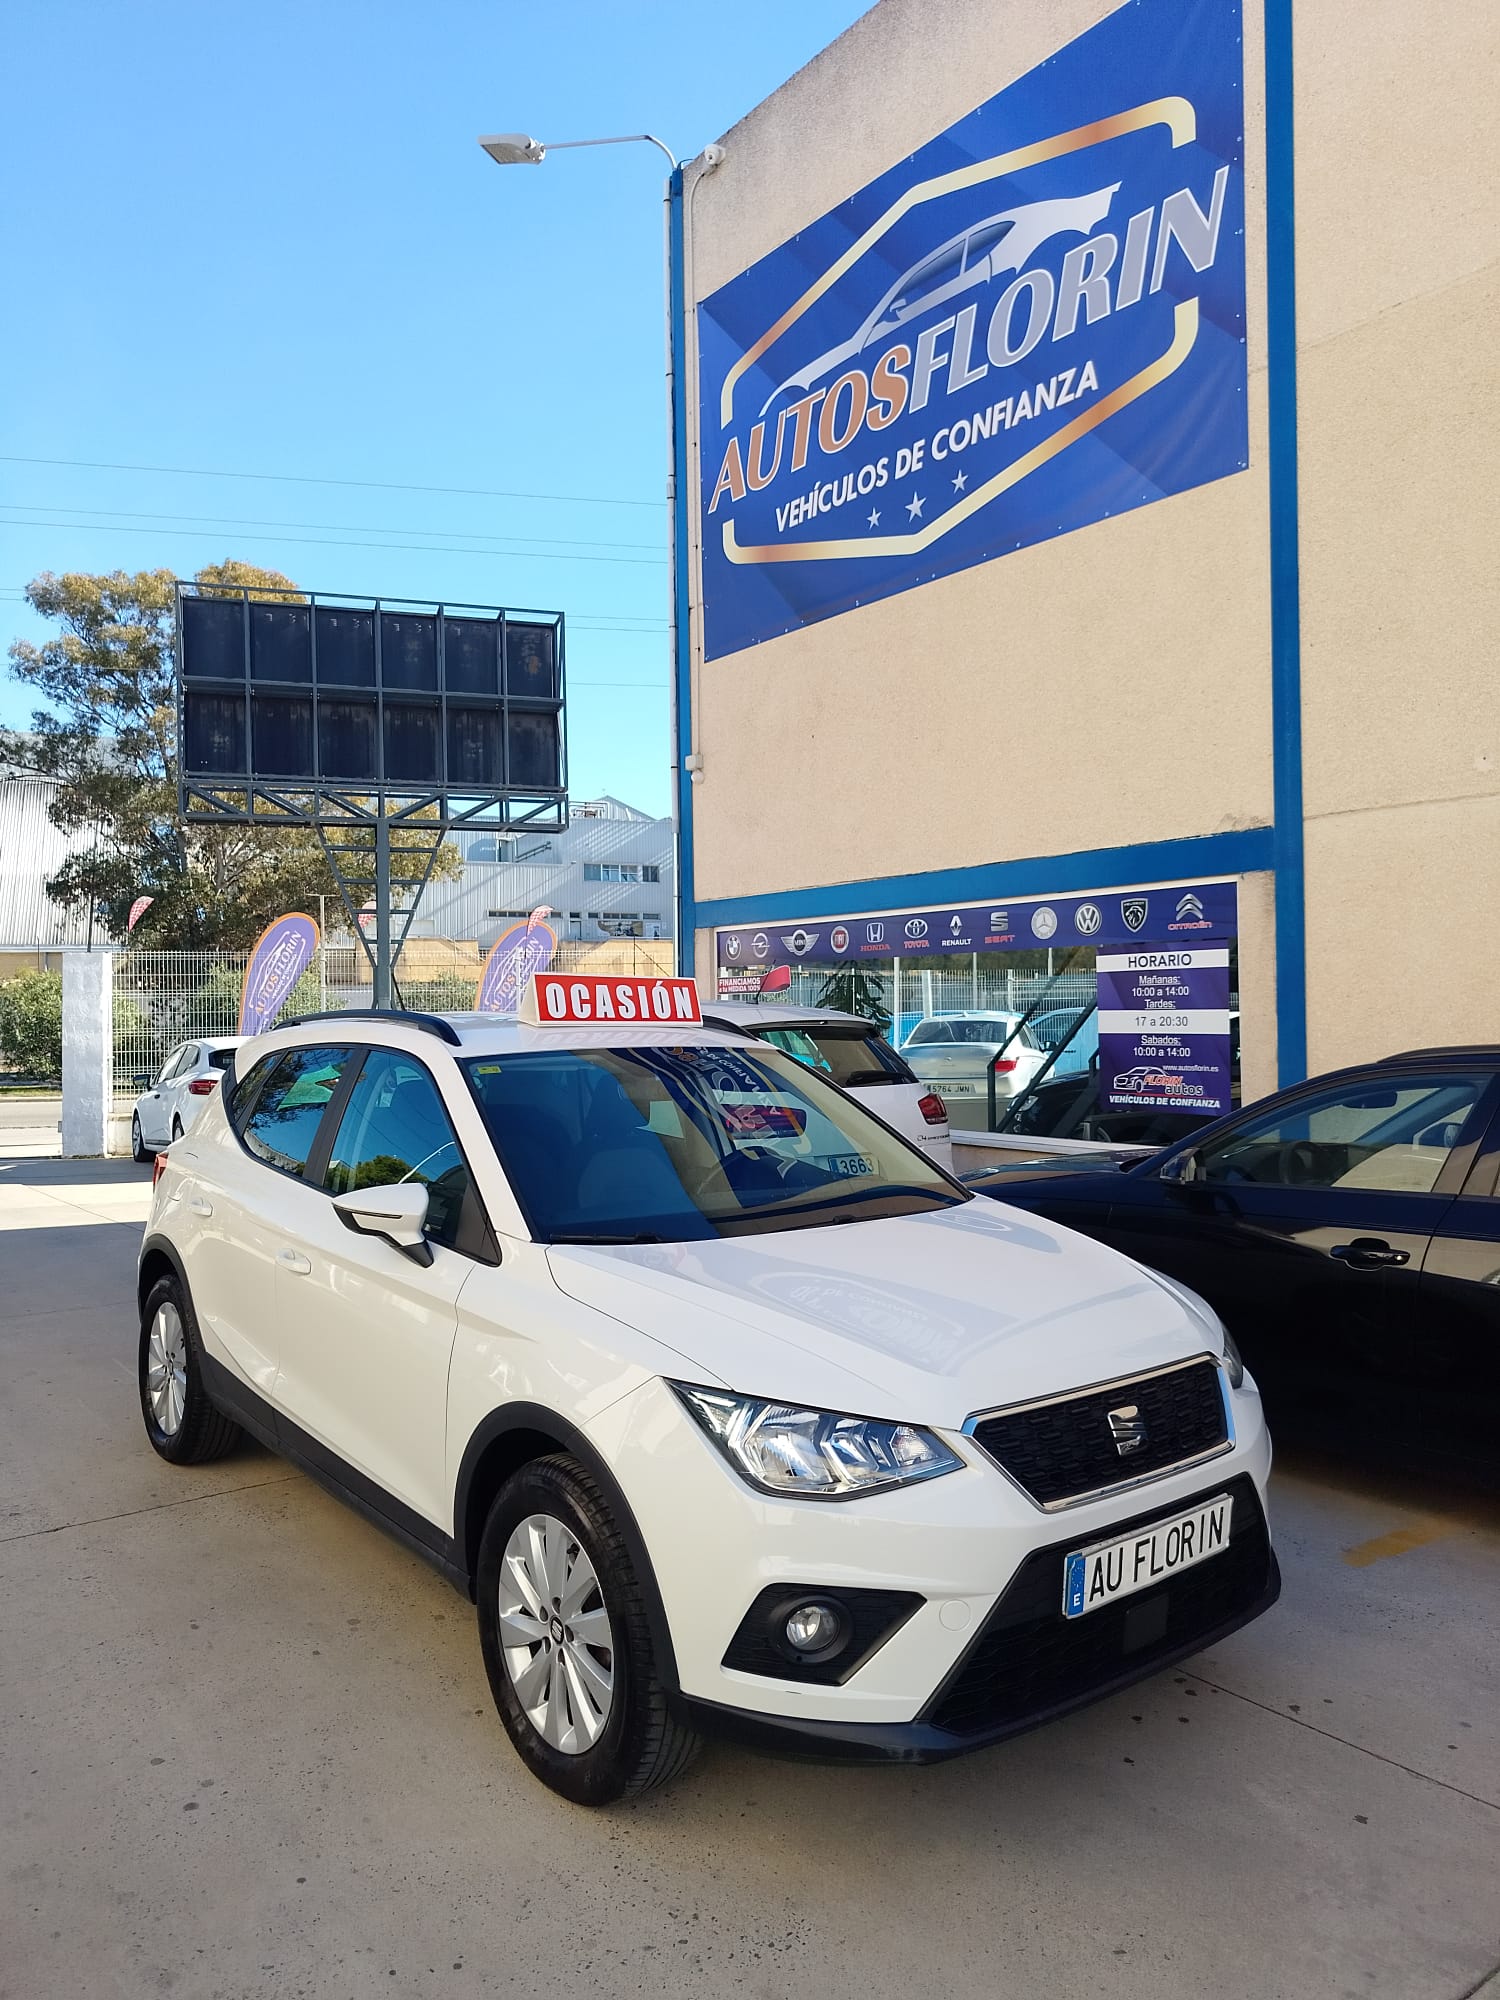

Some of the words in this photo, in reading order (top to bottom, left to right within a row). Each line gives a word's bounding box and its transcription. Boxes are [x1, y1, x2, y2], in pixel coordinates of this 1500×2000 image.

[775, 457, 889, 532] VEHÍCULOS
[894, 438, 926, 480] DE
[931, 360, 1099, 461] CONFIANZA
[903, 939, 930, 949] TOYOTA
[941, 938, 972, 947] RENAULT
[984, 934, 1016, 944] SEAT
[860, 943, 891, 952] HONDA
[1128, 953, 1192, 968] HORARIO
[719, 977, 760, 987] FINANCIAMOS
[1139, 975, 1181, 985] Mañanas:
[1132, 987, 1156, 997] 10:00
[1156, 988, 1163, 996] a
[1166, 986, 1190, 996] 14:00
[545, 980, 694, 1019] OCASIÓN
[1145, 999, 1176, 1009] Tardes:
[1136, 1016, 1147, 1027] 17
[1150, 1018, 1156, 1027] a
[1160, 1016, 1188, 1027] 20:30
[1141, 1034, 1181, 1045] Sabados:
[1133, 1046, 1156, 1056] 10:00
[1158, 1048, 1165, 1056] a
[1167, 1047, 1191, 1057] 14:00
[1143, 1074, 1184, 1086] FLORIN
[932, 1085, 952, 1093] 5764
[1164, 1083, 1204, 1096] autos
[1109, 1094, 1155, 1105] VEHÍCULOS
[1156, 1097, 1168, 1106] DE
[1169, 1098, 1221, 1109] CONFIANZA
[840, 1158, 874, 1175] 3663
[1088, 1547, 1124, 1602] AU
[1133, 1506, 1224, 1583] FLORIN
[1073, 1592, 1081, 1607] E
